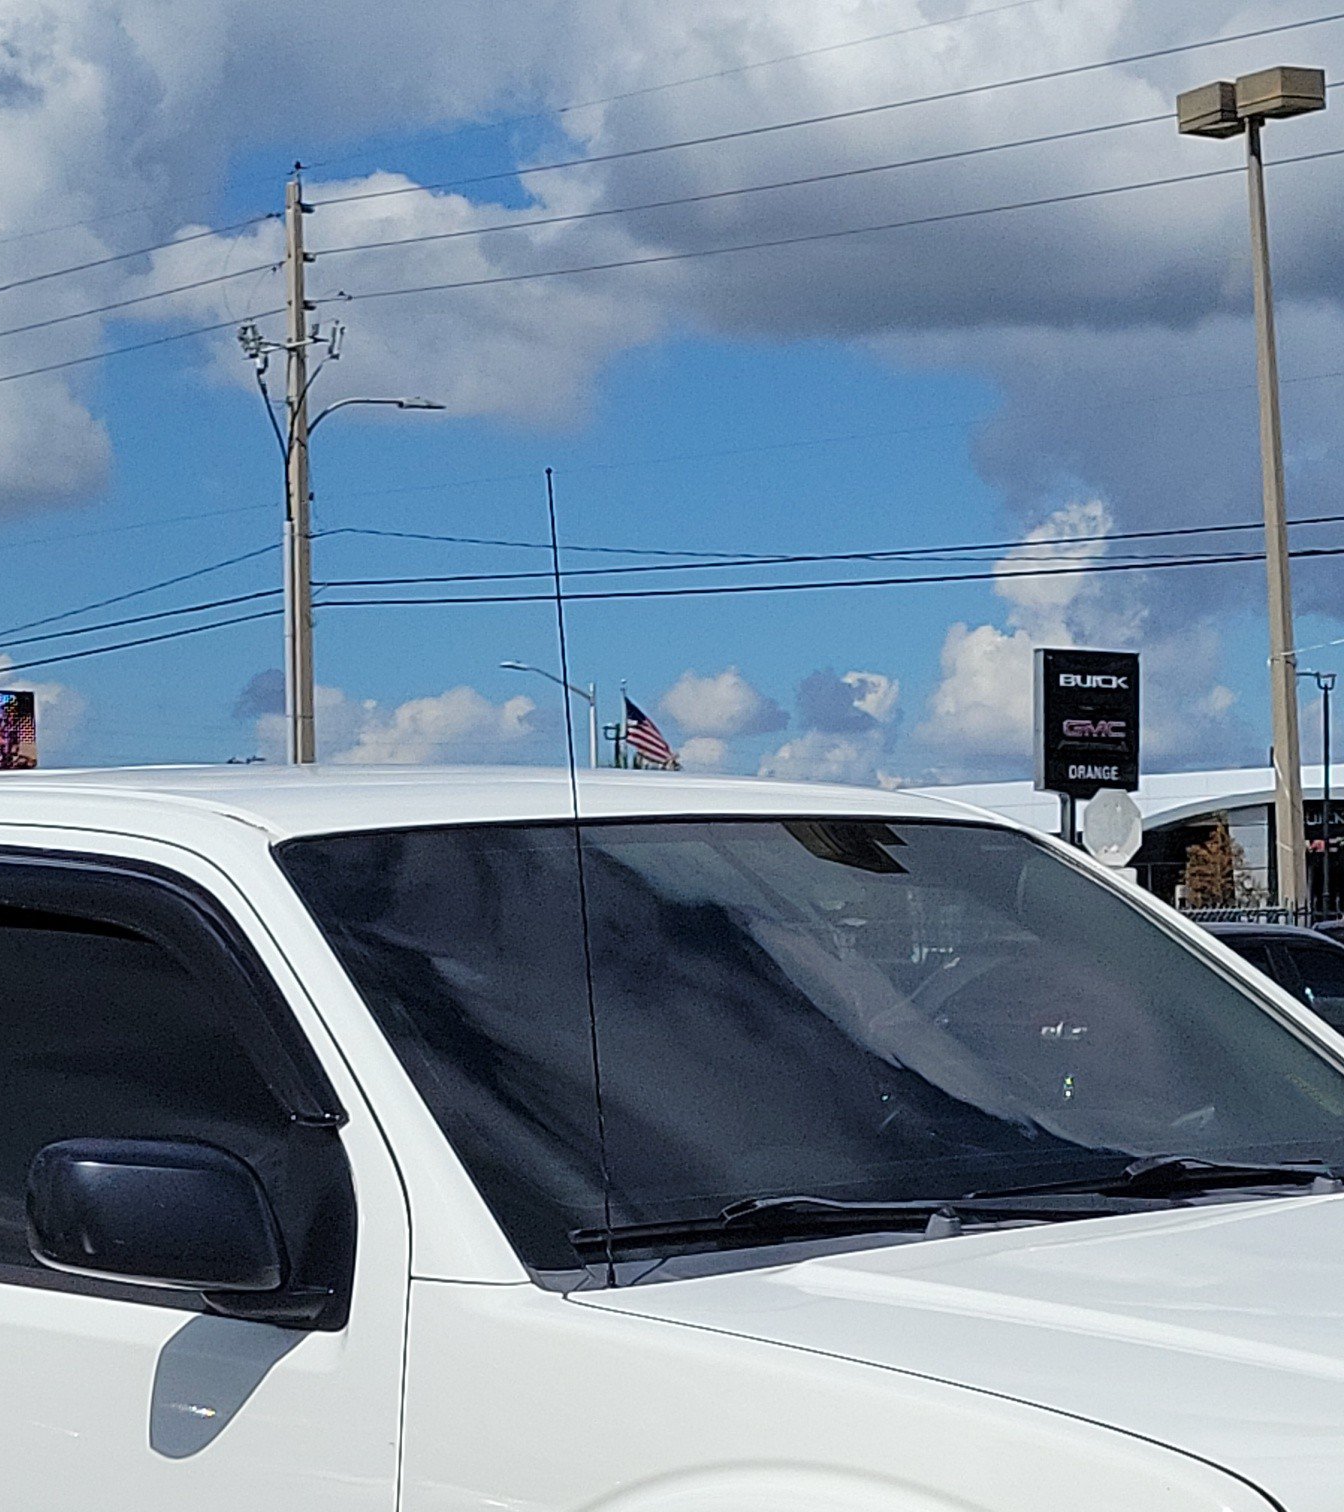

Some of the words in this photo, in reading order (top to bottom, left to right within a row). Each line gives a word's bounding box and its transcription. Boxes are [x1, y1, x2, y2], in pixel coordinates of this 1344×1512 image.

[1058, 673, 1129, 689] BUICK
[1062, 719, 1127, 738] GMC
[1068, 764, 1120, 781] ORANGE
